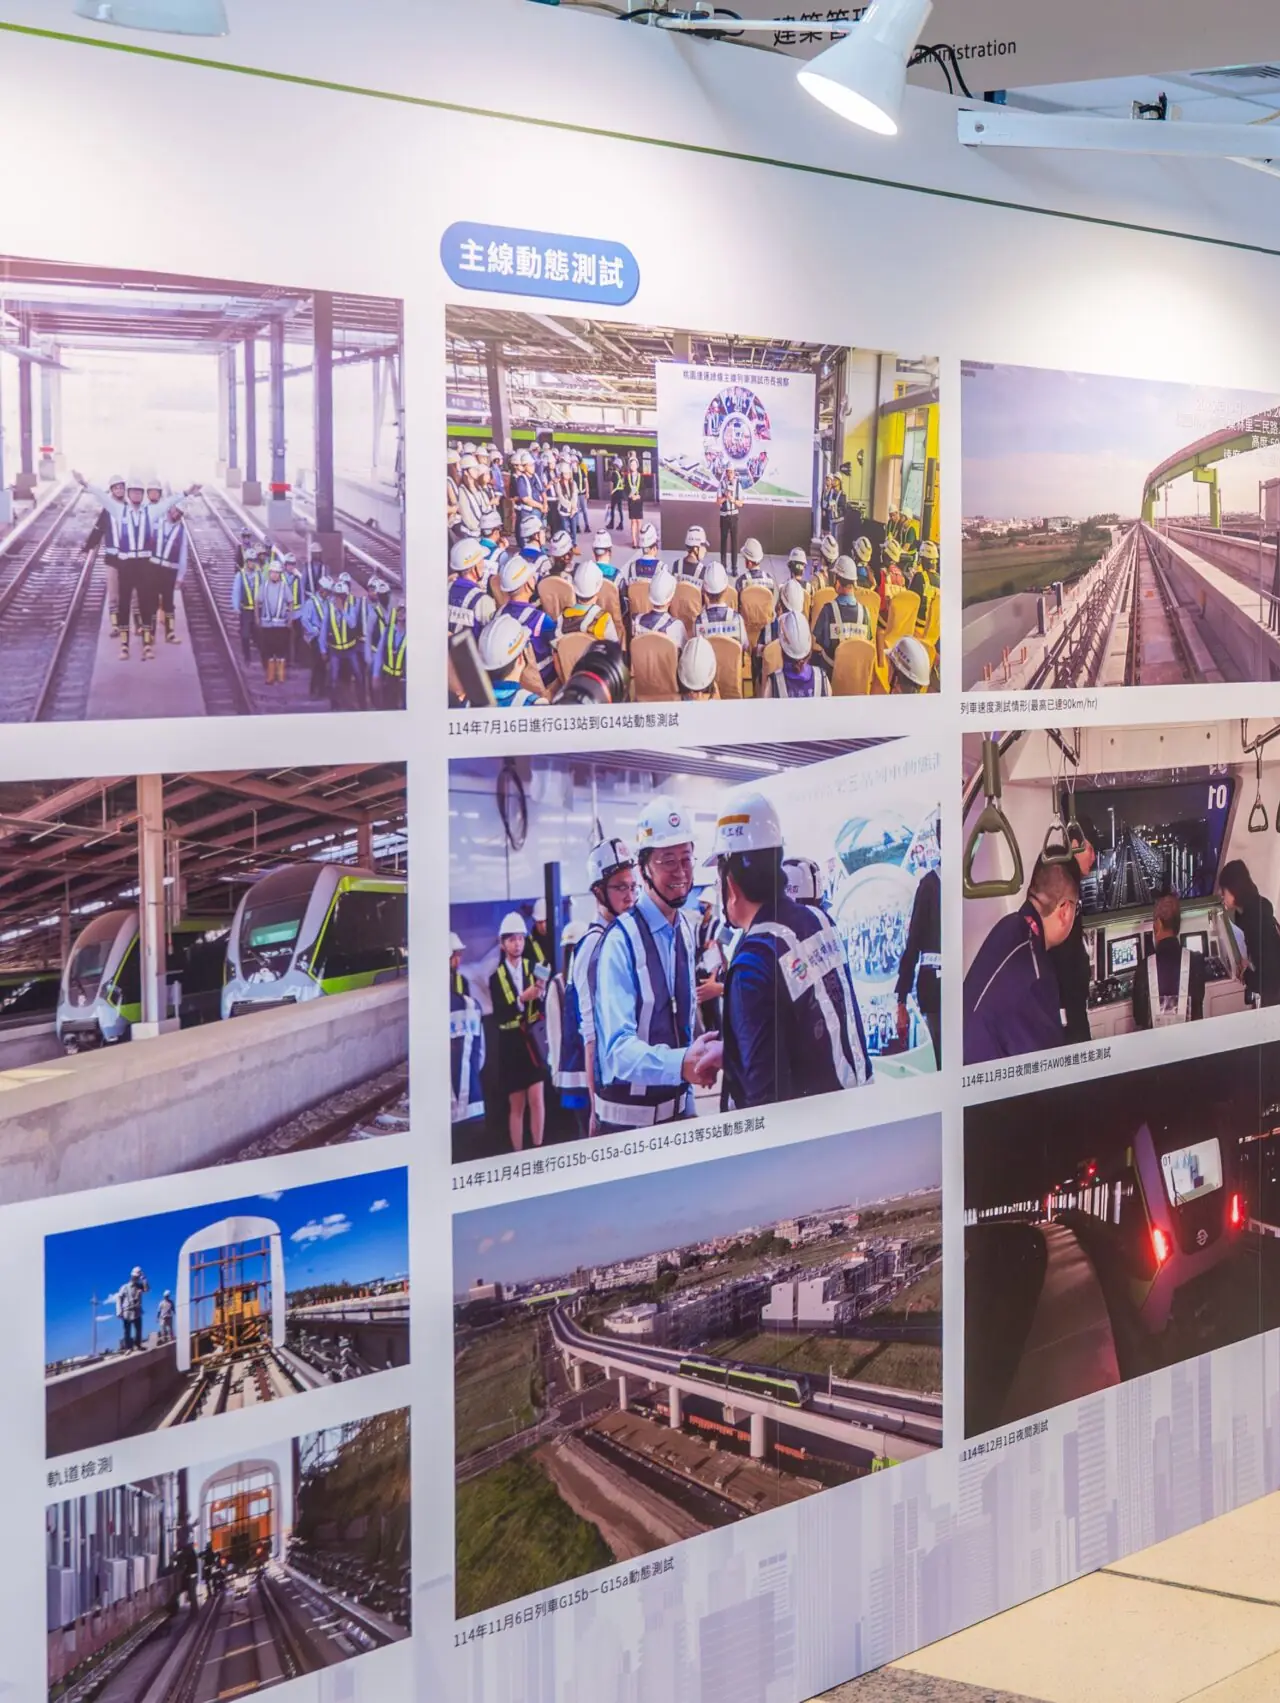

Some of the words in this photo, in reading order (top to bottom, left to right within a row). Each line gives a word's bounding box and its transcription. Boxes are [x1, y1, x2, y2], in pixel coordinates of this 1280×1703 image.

[459, 238, 624, 289] 主線動態測試
[448, 712, 680, 736] 114年7月16日進行G13站到G14站動態測試
[47, 1455, 113, 1488] 軌道檢測
